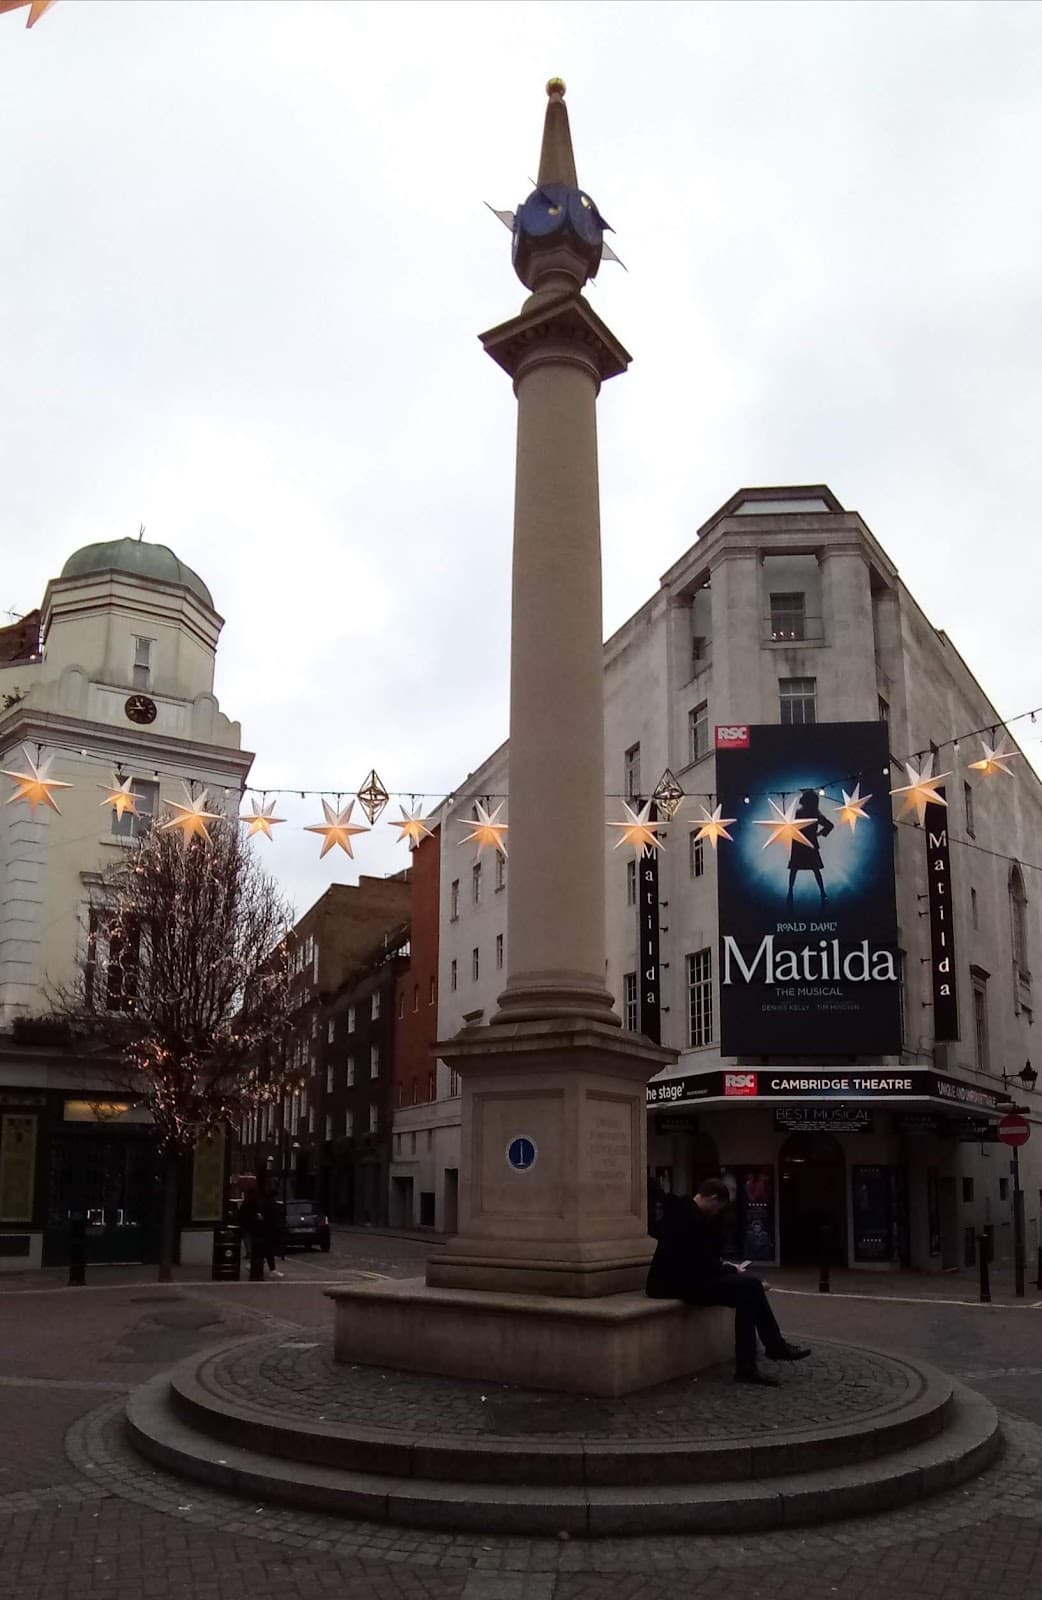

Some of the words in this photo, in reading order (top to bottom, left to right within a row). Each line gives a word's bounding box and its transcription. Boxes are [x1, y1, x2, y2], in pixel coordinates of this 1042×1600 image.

[718, 727, 747, 739] RSC
[928, 830, 952, 997] Matilda
[777, 922, 806, 933] ROALD
[723, 935, 898, 985] Matilda
[776, 987, 797, 997] THE
[798, 986, 843, 996] MUSICAL
[725, 1074, 755, 1087] RSC
[771, 1079, 849, 1090] CAMBRIDGE
[853, 1079, 912, 1090] THEATRE
[646, 1086, 657, 1101] he
[775, 1107, 808, 1120] BEST
[814, 1108, 873, 1121] MUSICAL
